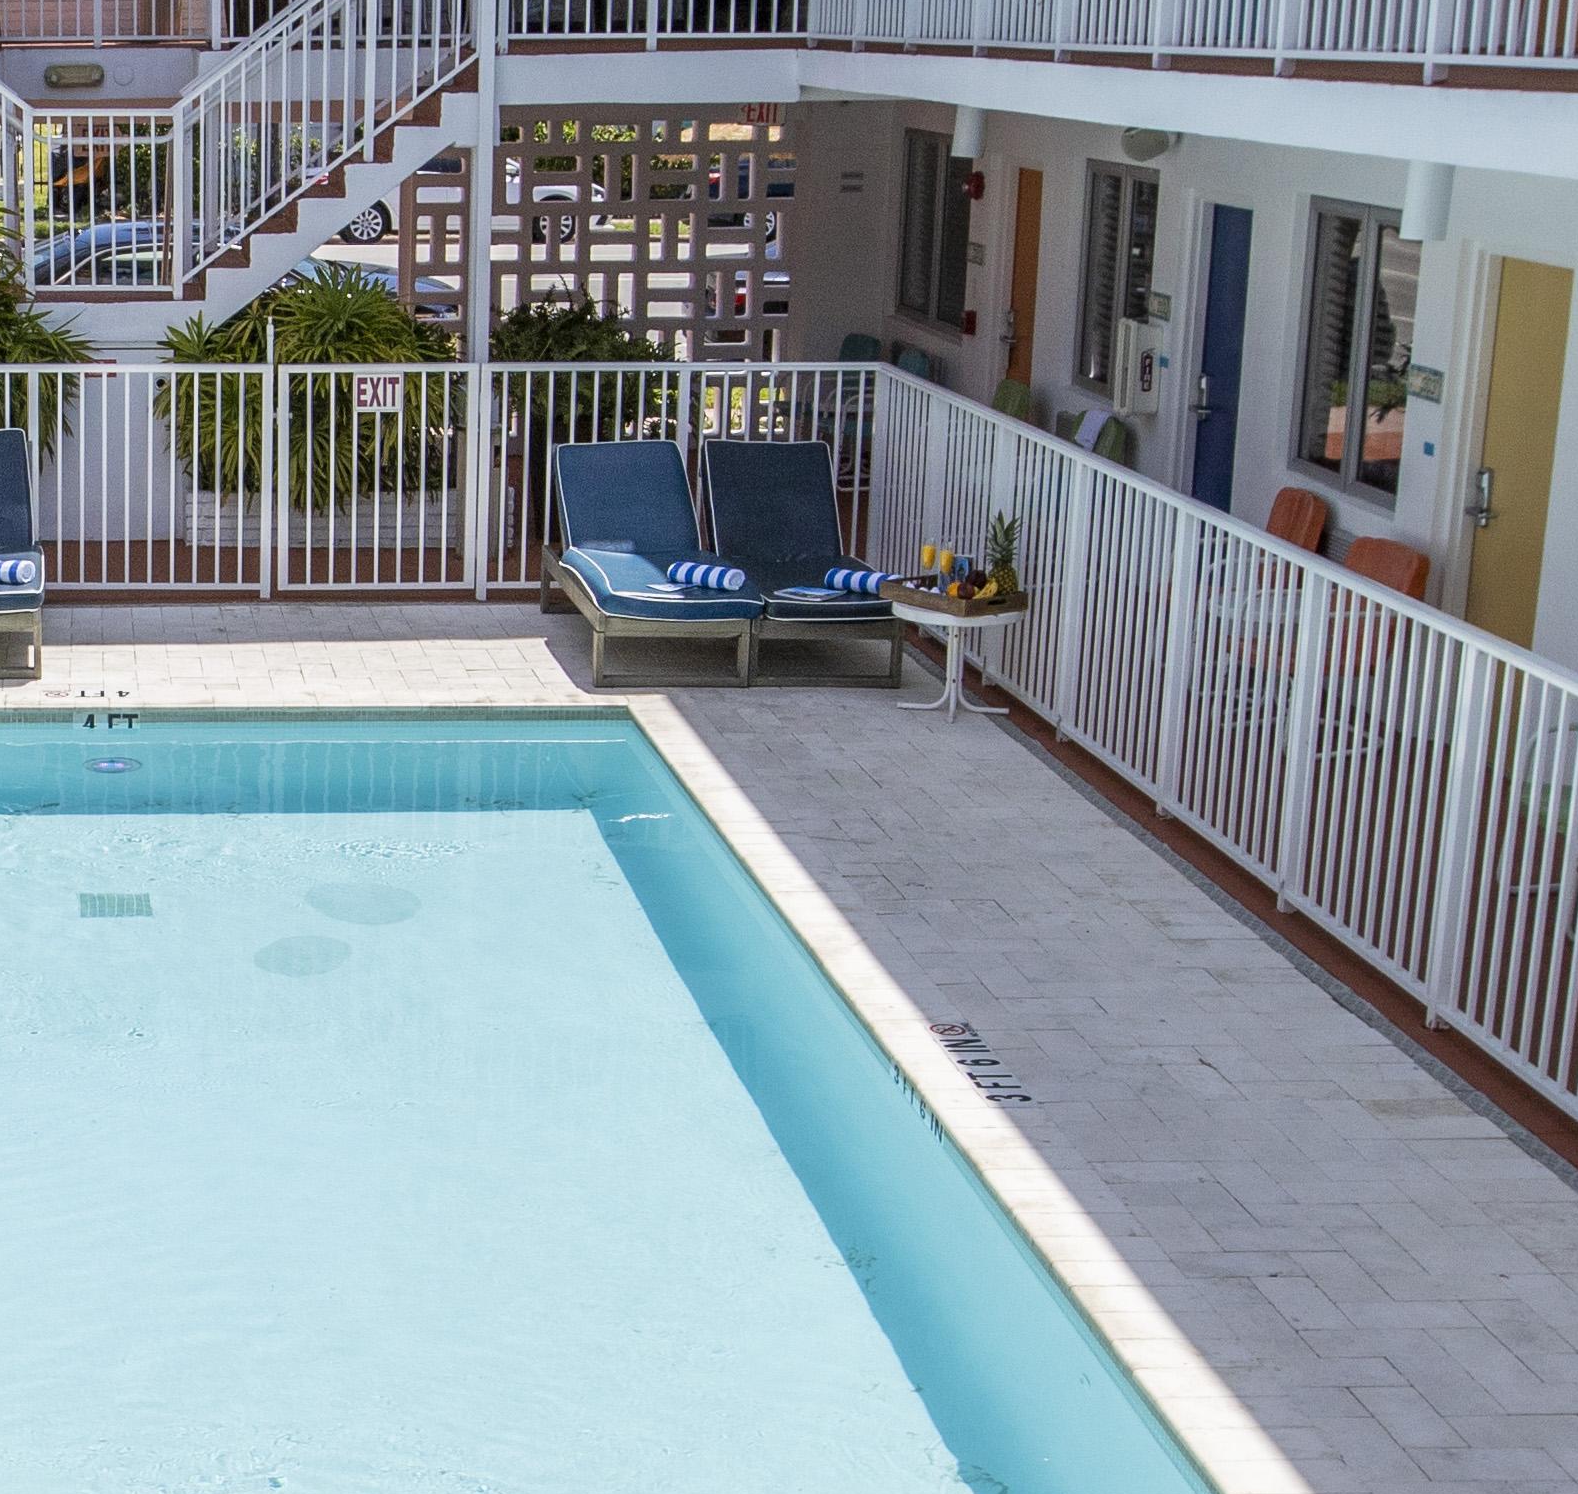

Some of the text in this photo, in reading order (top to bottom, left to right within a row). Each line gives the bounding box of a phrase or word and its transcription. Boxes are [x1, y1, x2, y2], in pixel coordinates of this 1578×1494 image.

[357, 377, 400, 407] EXIT
[82, 713, 139, 729] 4 FT
[940, 1039, 1032, 1102] 3 FT 6 IN
[930, 1113, 943, 1143] IN
